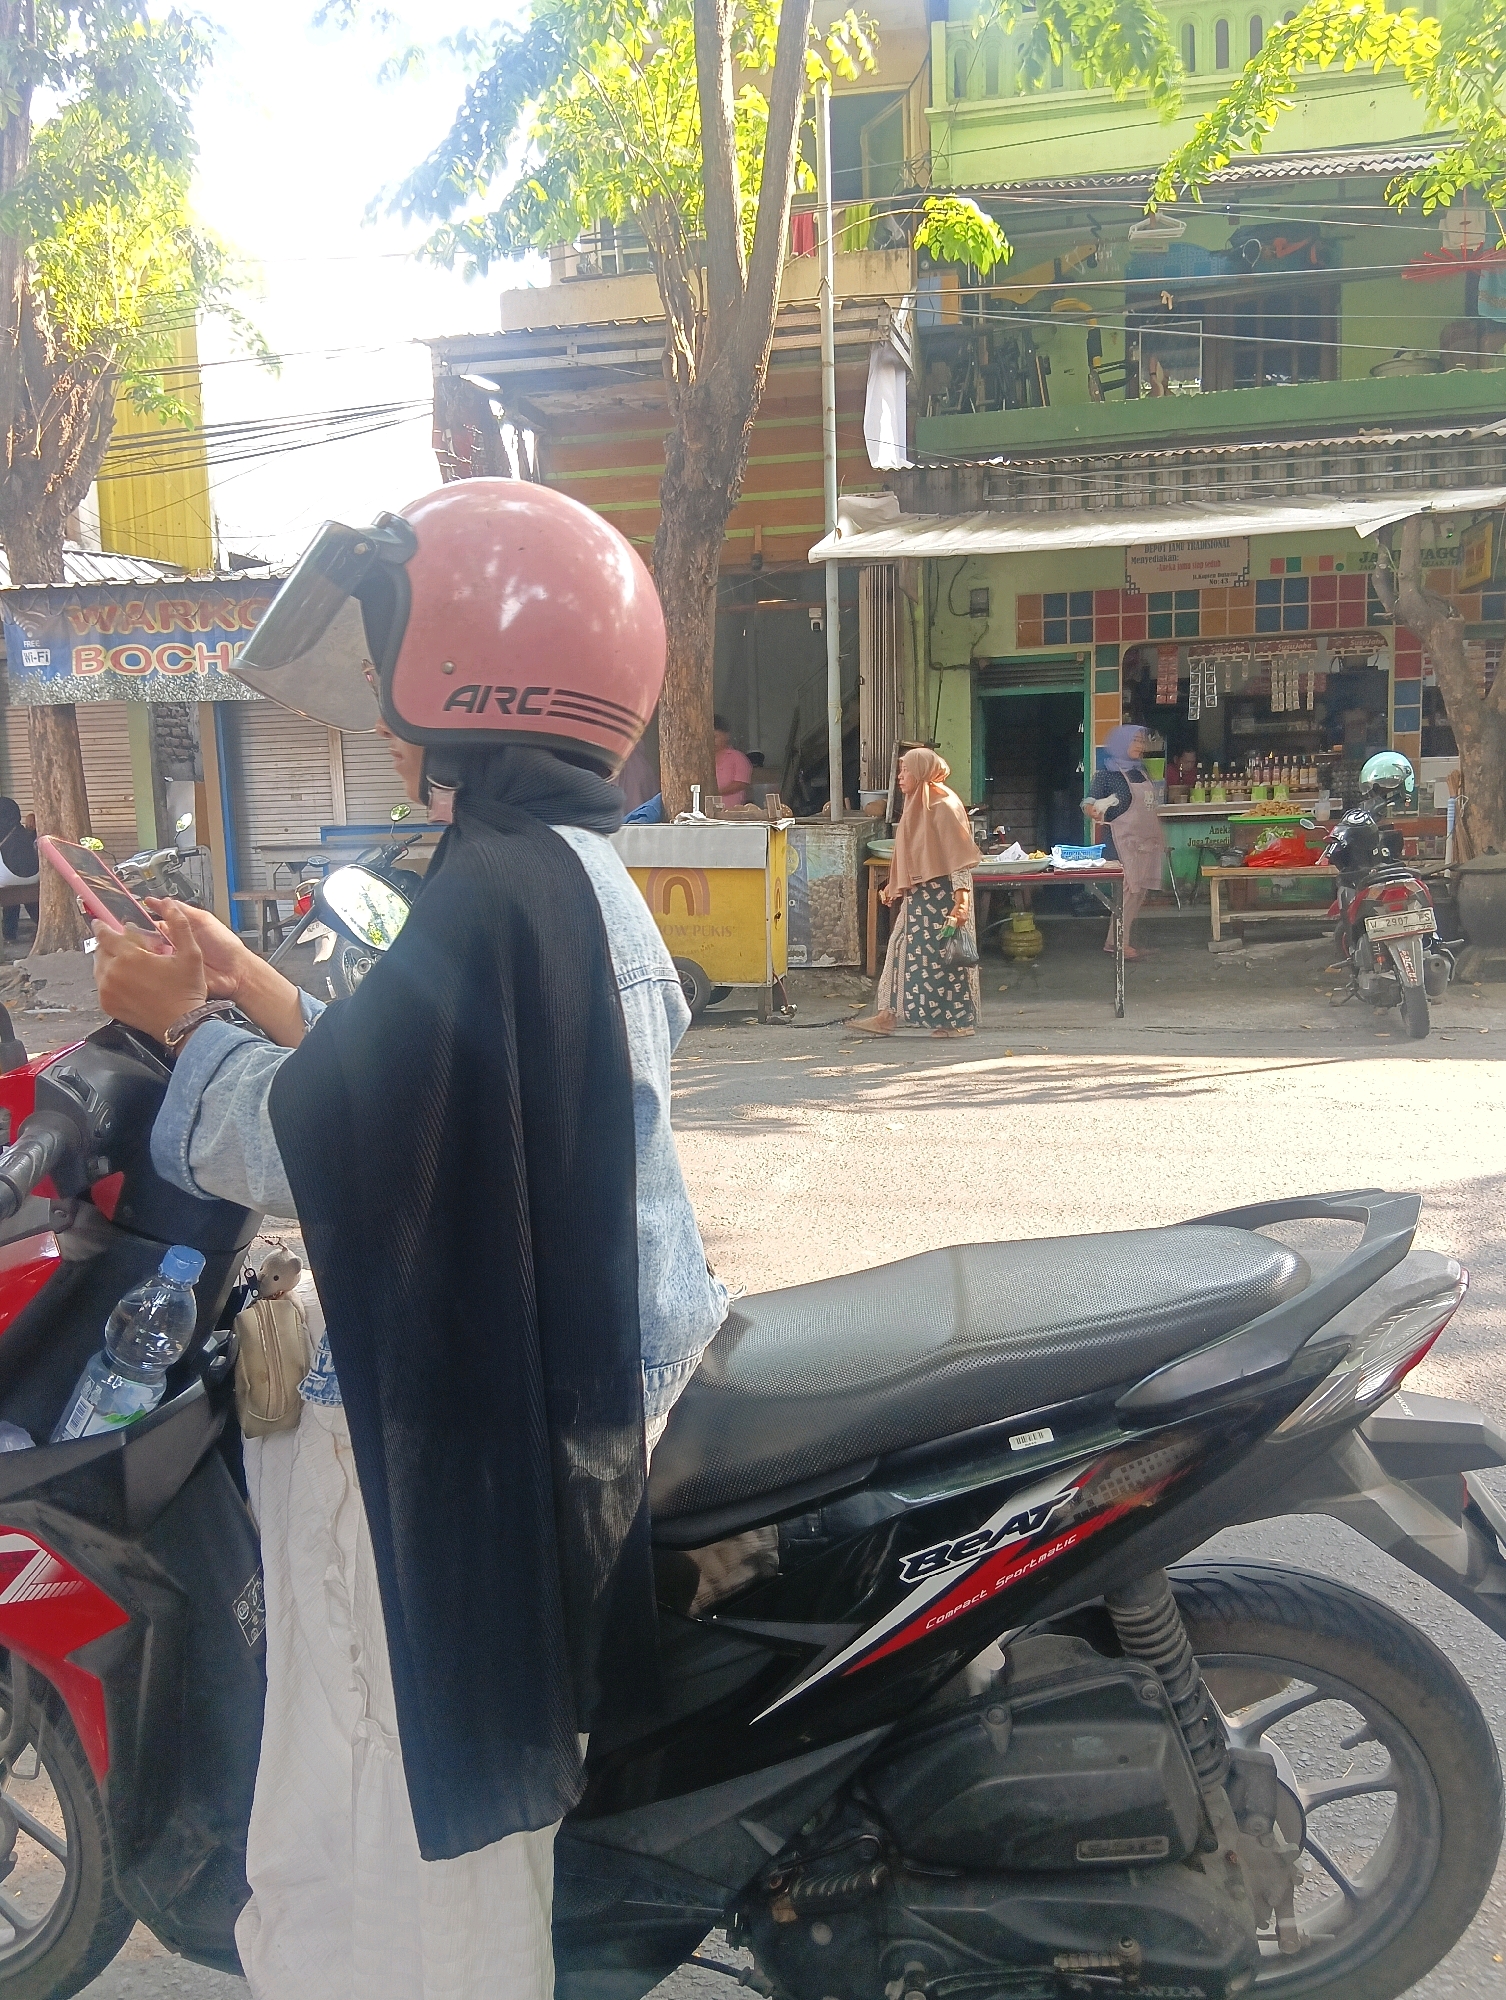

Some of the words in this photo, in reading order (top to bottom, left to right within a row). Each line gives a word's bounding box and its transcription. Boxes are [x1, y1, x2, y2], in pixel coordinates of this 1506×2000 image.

[1145, 543, 1166, 553] DEPOT
[1168, 541, 1184, 552] JAMU
[1187, 538, 1231, 551] TRADISIONAL
[1131, 554, 1179, 564] Menyediakan:
[23, 640, 40, 648] FREE
[73, 641, 245, 676] BOCH
[1385, 917, 1409, 927] 2907
[692, 925, 732, 937] PUKIS
